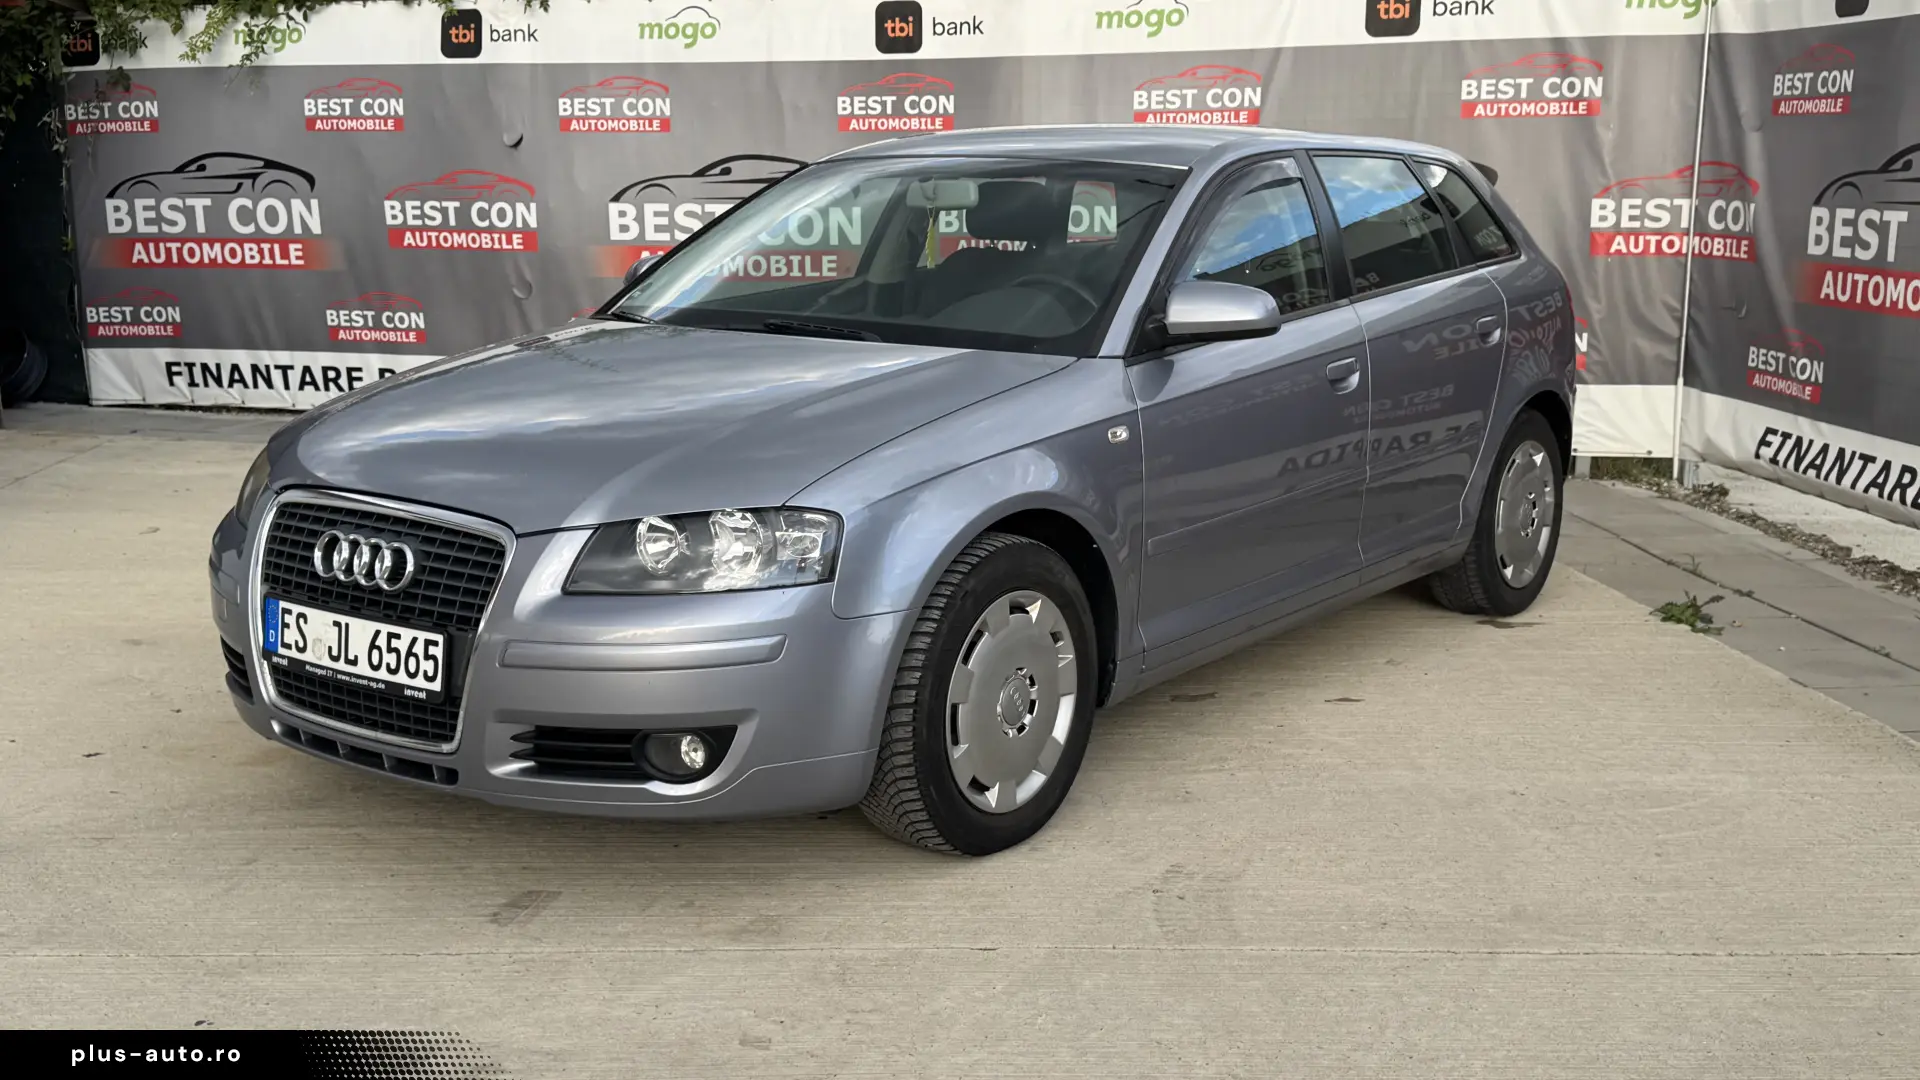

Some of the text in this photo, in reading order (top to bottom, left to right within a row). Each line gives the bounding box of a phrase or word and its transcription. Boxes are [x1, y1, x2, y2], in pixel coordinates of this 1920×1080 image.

[885, 16, 983, 37] tbi bank
[1096, 8, 1184, 37] mogo
[449, 24, 538, 43] tbi bank
[639, 22, 716, 49] mogo
[1461, 77, 1603, 100] BEST CON
[1773, 70, 1854, 96] BEST CON
[304, 98, 403, 116] BEST CON
[559, 98, 670, 116] BEST CON
[837, 95, 954, 115] BEST CON
[1134, 87, 1261, 109] BEST CON
[1779, 98, 1843, 113] AUTOMOBILE
[66, 101, 158, 121] BEST CON
[1143, 111, 1249, 124] AUTOMOBILE
[1474, 102, 1587, 116] AUTOMOBILE
[76, 120, 151, 134] AUTOMOBILE
[316, 119, 394, 130] AUTOMOBILE
[571, 120, 660, 130] AUTOMOBILE
[850, 118, 942, 130] AUTOMOBILE
[106, 198, 321, 234] BEST CON
[384, 201, 537, 228] BEST CON
[1590, 198, 1756, 233] BEST CON
[404, 232, 523, 249] AUTOMOBILE
[1808, 207, 1908, 262] BEST
[133, 242, 304, 265] AUTOMOBILE
[1609, 235, 1748, 259] AUTOMOBILE
[86, 307, 180, 322] BEST CON
[326, 310, 424, 328] BEST CON
[98, 325, 173, 335] AUTOMOBILE
[339, 330, 416, 342] AUTOMOBILE
[1748, 346, 1825, 385] BEST CON
[166, 361, 364, 391] FINANTARE
[1752, 373, 1812, 400] AUTOMOBILE
[281, 607, 308, 654] ES
[328, 620, 358, 667] JL
[367, 629, 439, 683] 6565
[404, 687, 427, 700] invent
